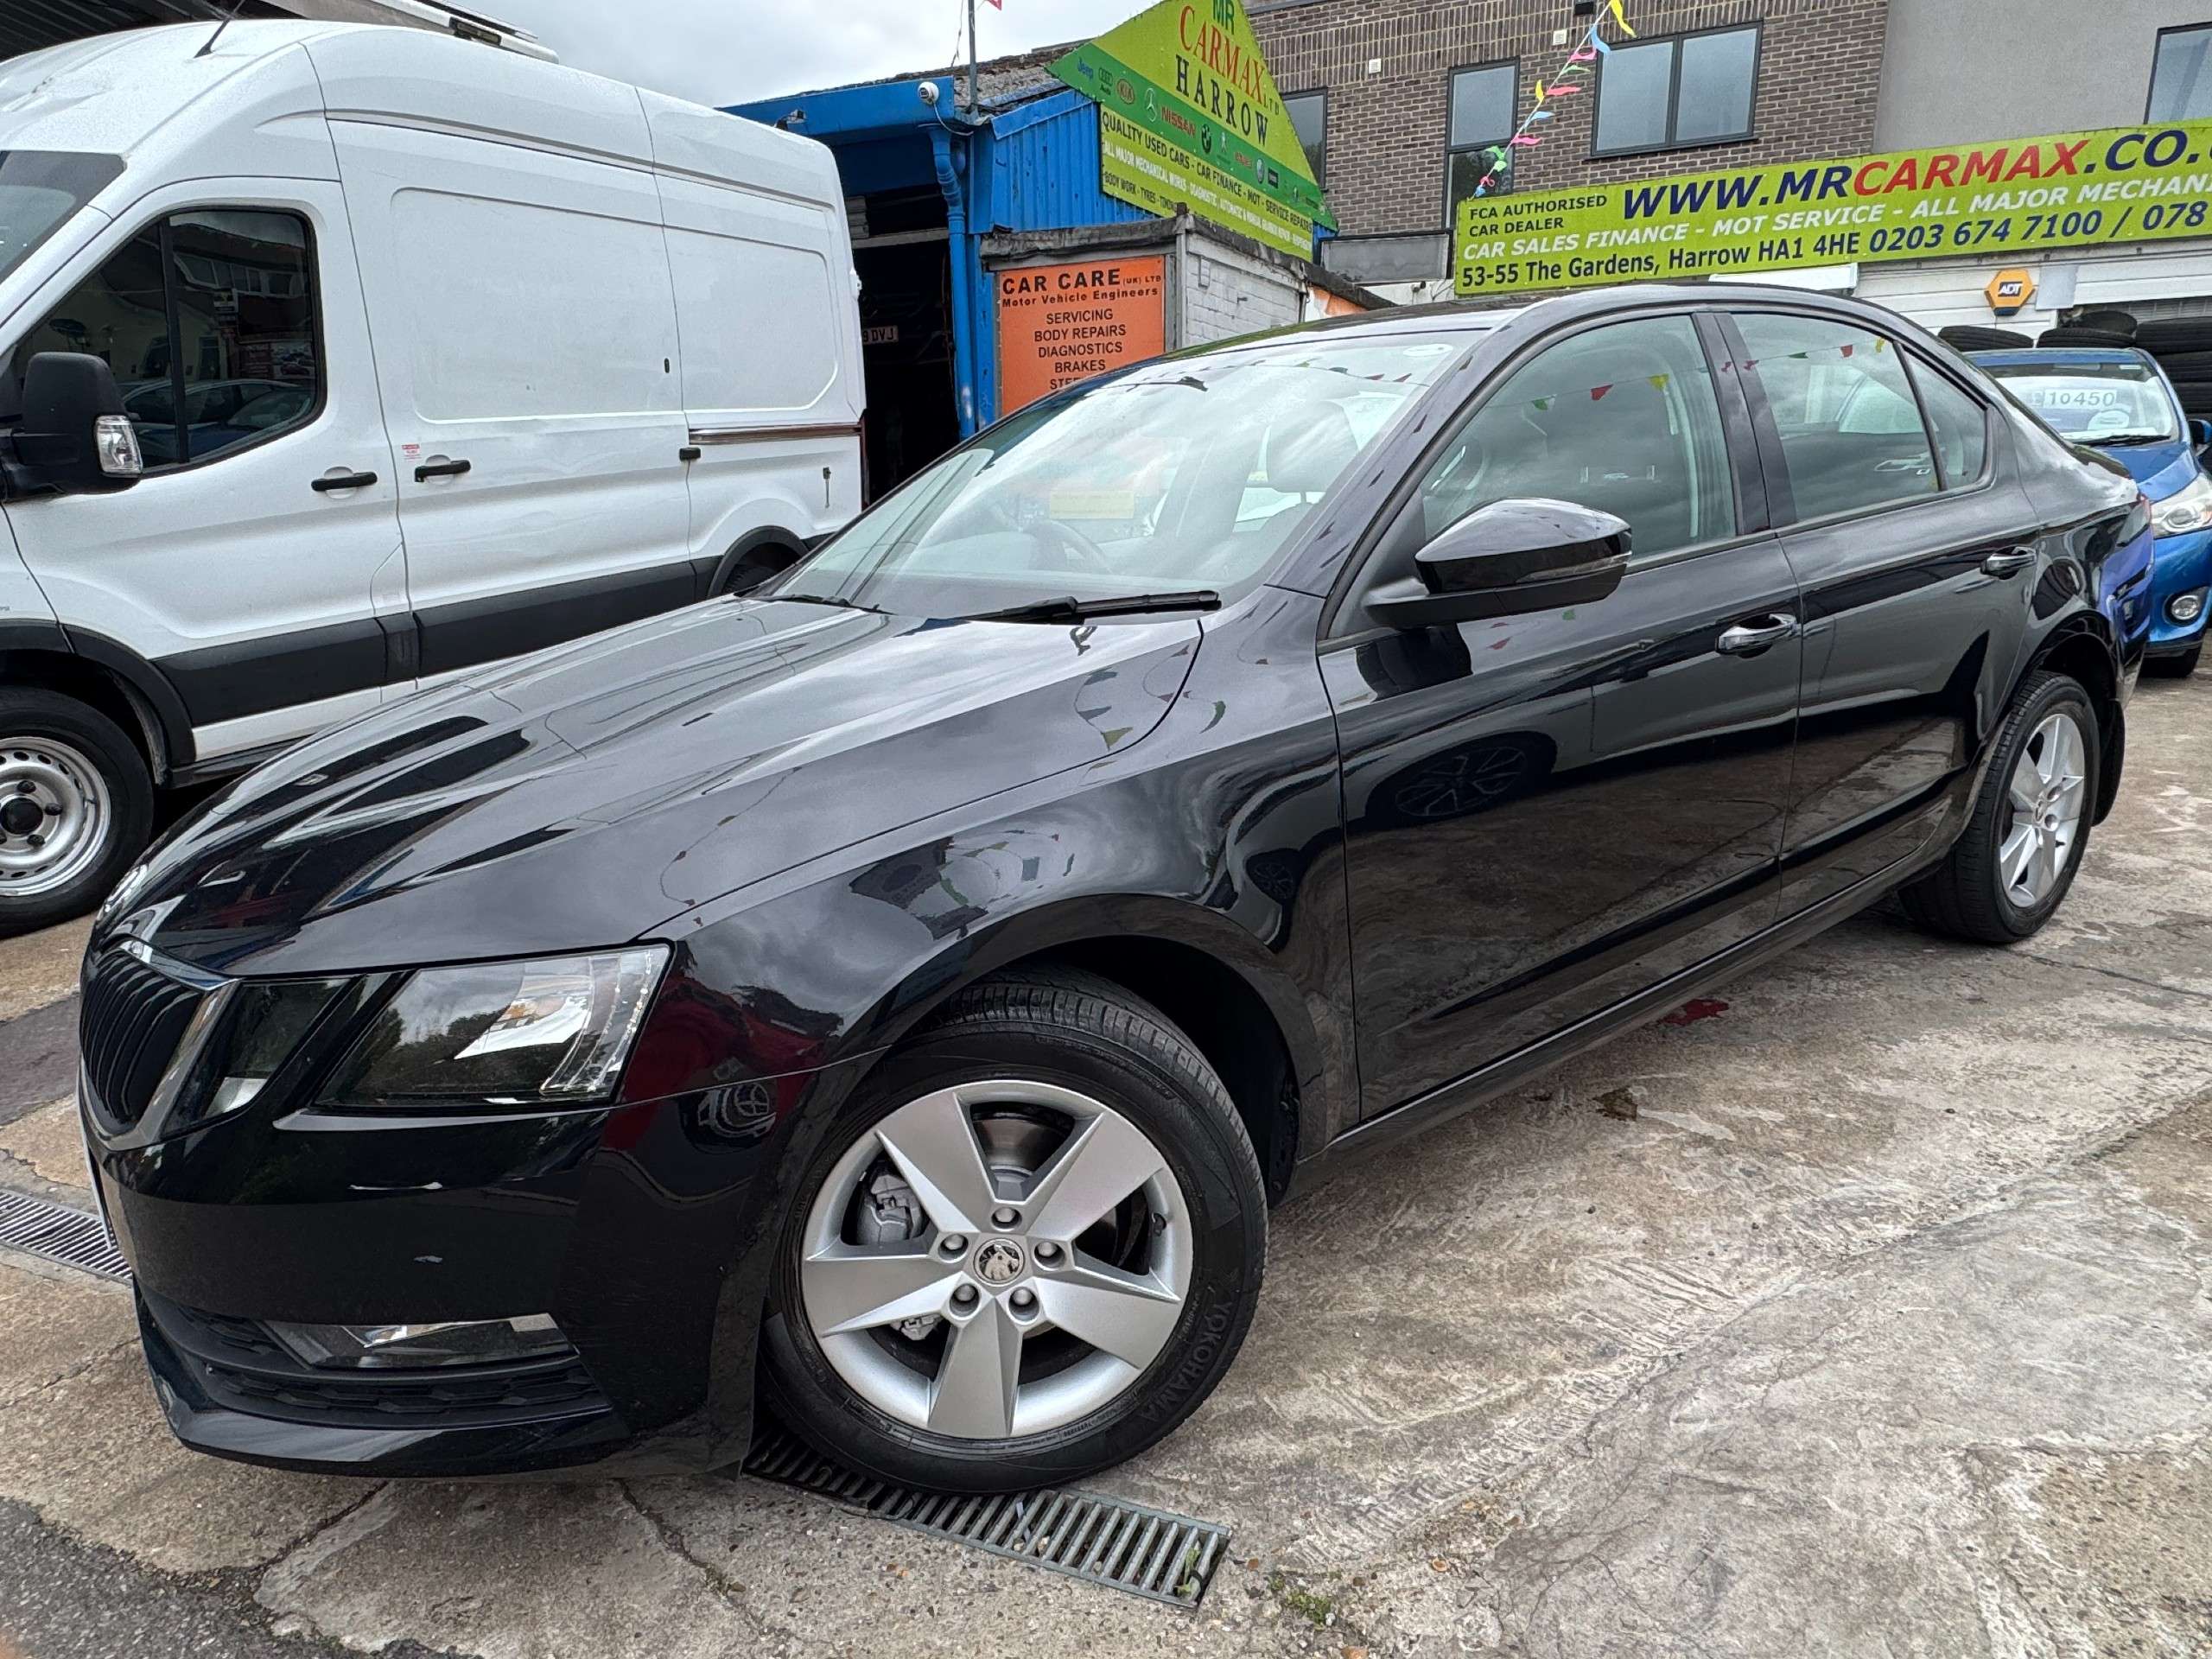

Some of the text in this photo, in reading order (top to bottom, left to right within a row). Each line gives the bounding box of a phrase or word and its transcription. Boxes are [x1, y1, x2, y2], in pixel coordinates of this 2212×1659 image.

[1213, 0, 1235, 35] MR
[1180, 5, 1280, 115] CARMAX LTD
[1176, 54, 1268, 146] HARROW
[1161, 106, 1196, 136] NISSAN
[1102, 111, 1142, 145] QUALITY
[1145, 132, 1167, 157] USED
[1169, 148, 1190, 169] CARS
[1197, 162, 1211, 182] CAR
[1212, 171, 1242, 198] FINANCE
[1248, 189, 1261, 207] MOT
[1265, 200, 1289, 222] SERVICE
[1624, 129, 2212, 220] WWW.MRCARMAX.CO.
[1470, 194, 1608, 220] FCA AUTHORISED
[1463, 241, 1505, 261] CAR
[1510, 234, 1580, 257] SALES
[1586, 222, 1690, 250] FINANCE
[1713, 215, 1765, 238] MOT
[1771, 203, 1886, 231] SERVICE
[1910, 198, 1961, 219] ALL
[1969, 186, 2069, 213] MAJOR
[1469, 217, 1565, 238] CAR DEALER
[1462, 200, 2209, 288] 53-55 The Gardens, Harrow HA1 4HE 0203 674 7100 / 078
[1002, 276, 1048, 296] CAR
[1058, 268, 1122, 290] CARE
[1123, 276, 1142, 286] (UK)
[1999, 283, 2024, 295] ADT
[1002, 287, 1159, 308] Motor Vehicle Engineers
[1046, 308, 1114, 325] SERVICING
[1034, 324, 1127, 343] BODY REPAIRS
[1038, 341, 1123, 359] DIAGNOSTICS
[1054, 359, 1106, 373] BRAKES
[1140, 1300, 1233, 1422] YOKOHAMA
